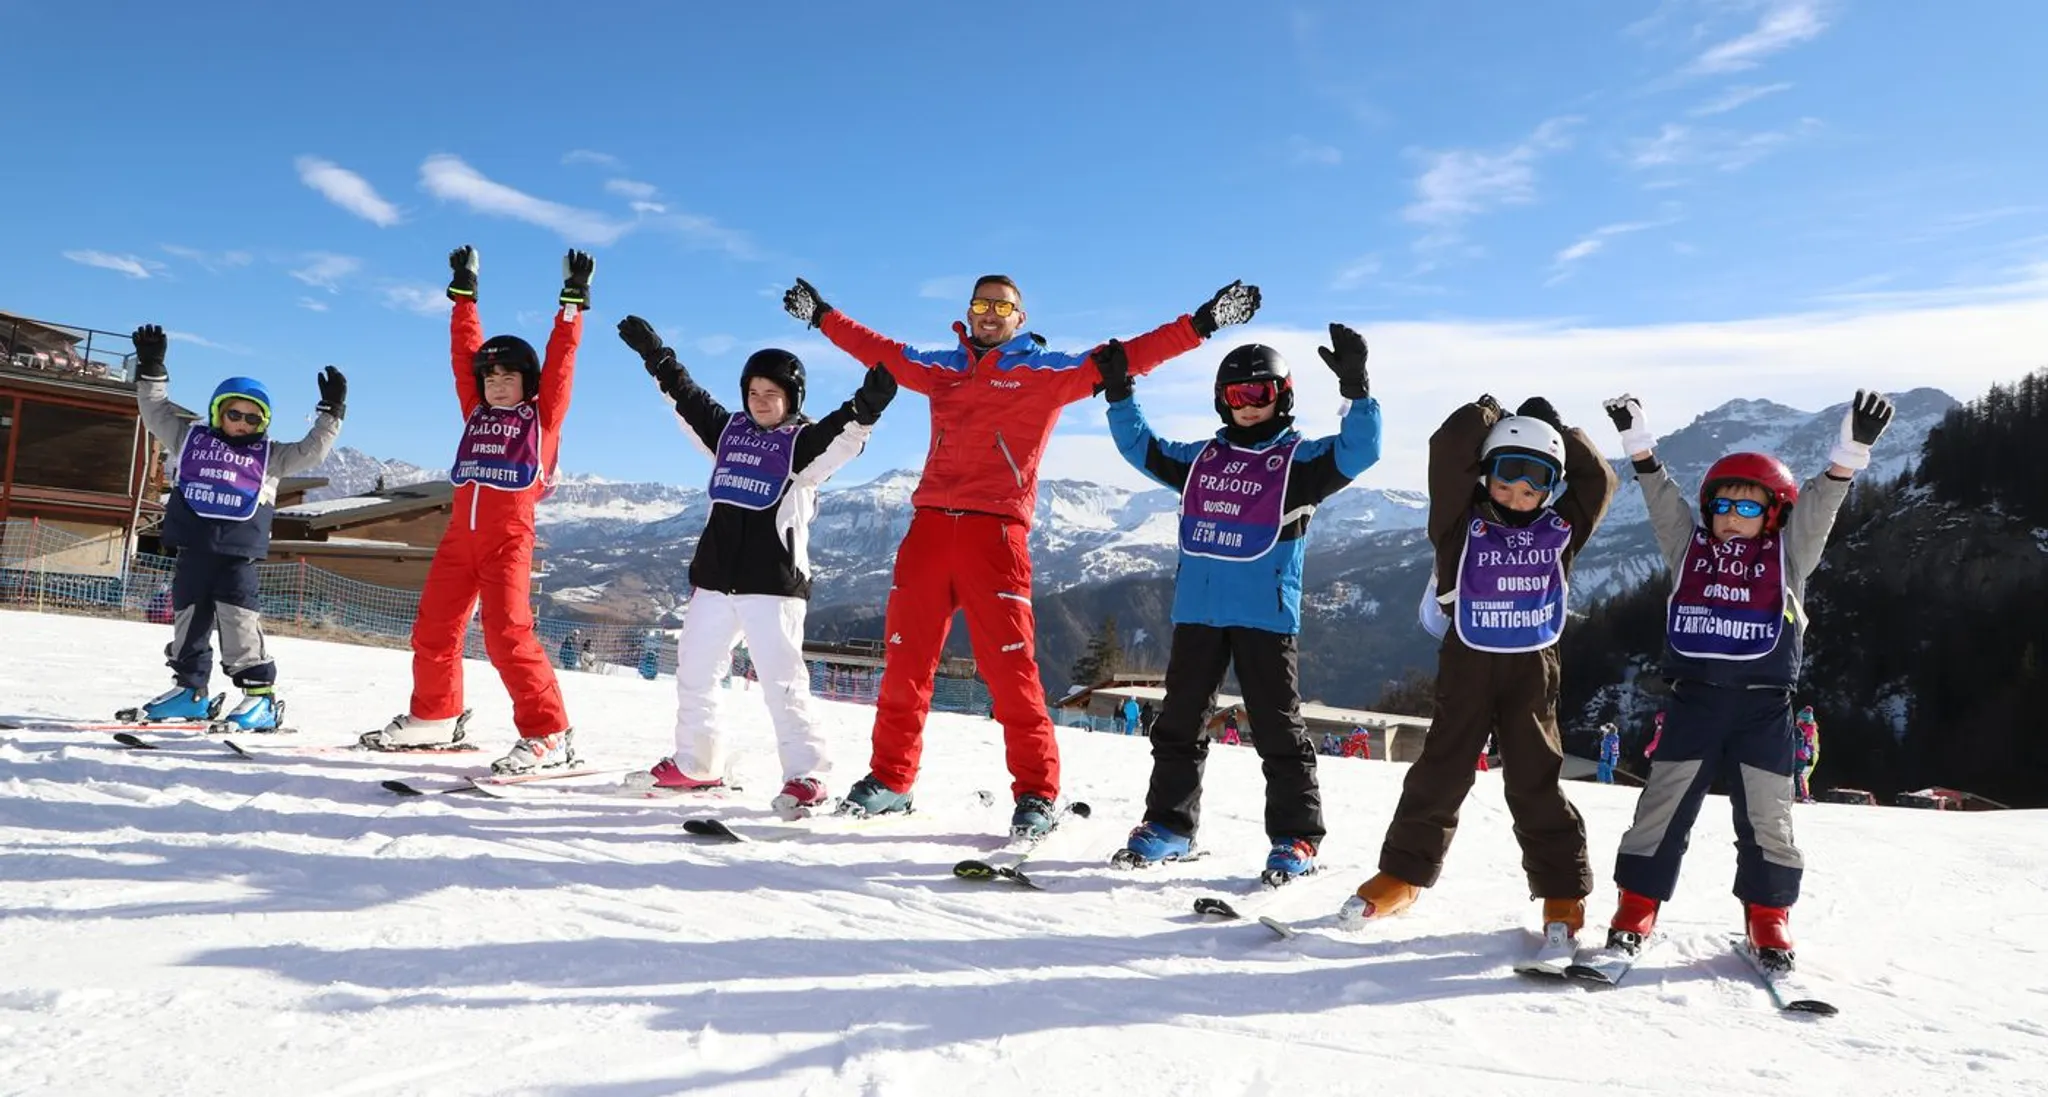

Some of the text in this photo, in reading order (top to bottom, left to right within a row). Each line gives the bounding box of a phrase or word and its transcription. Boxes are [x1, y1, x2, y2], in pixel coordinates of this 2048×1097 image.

[191, 449, 254, 467] PRALOUP
[216, 492, 242, 508] NOIR
[1472, 601, 1514, 610] RESTAURANT
